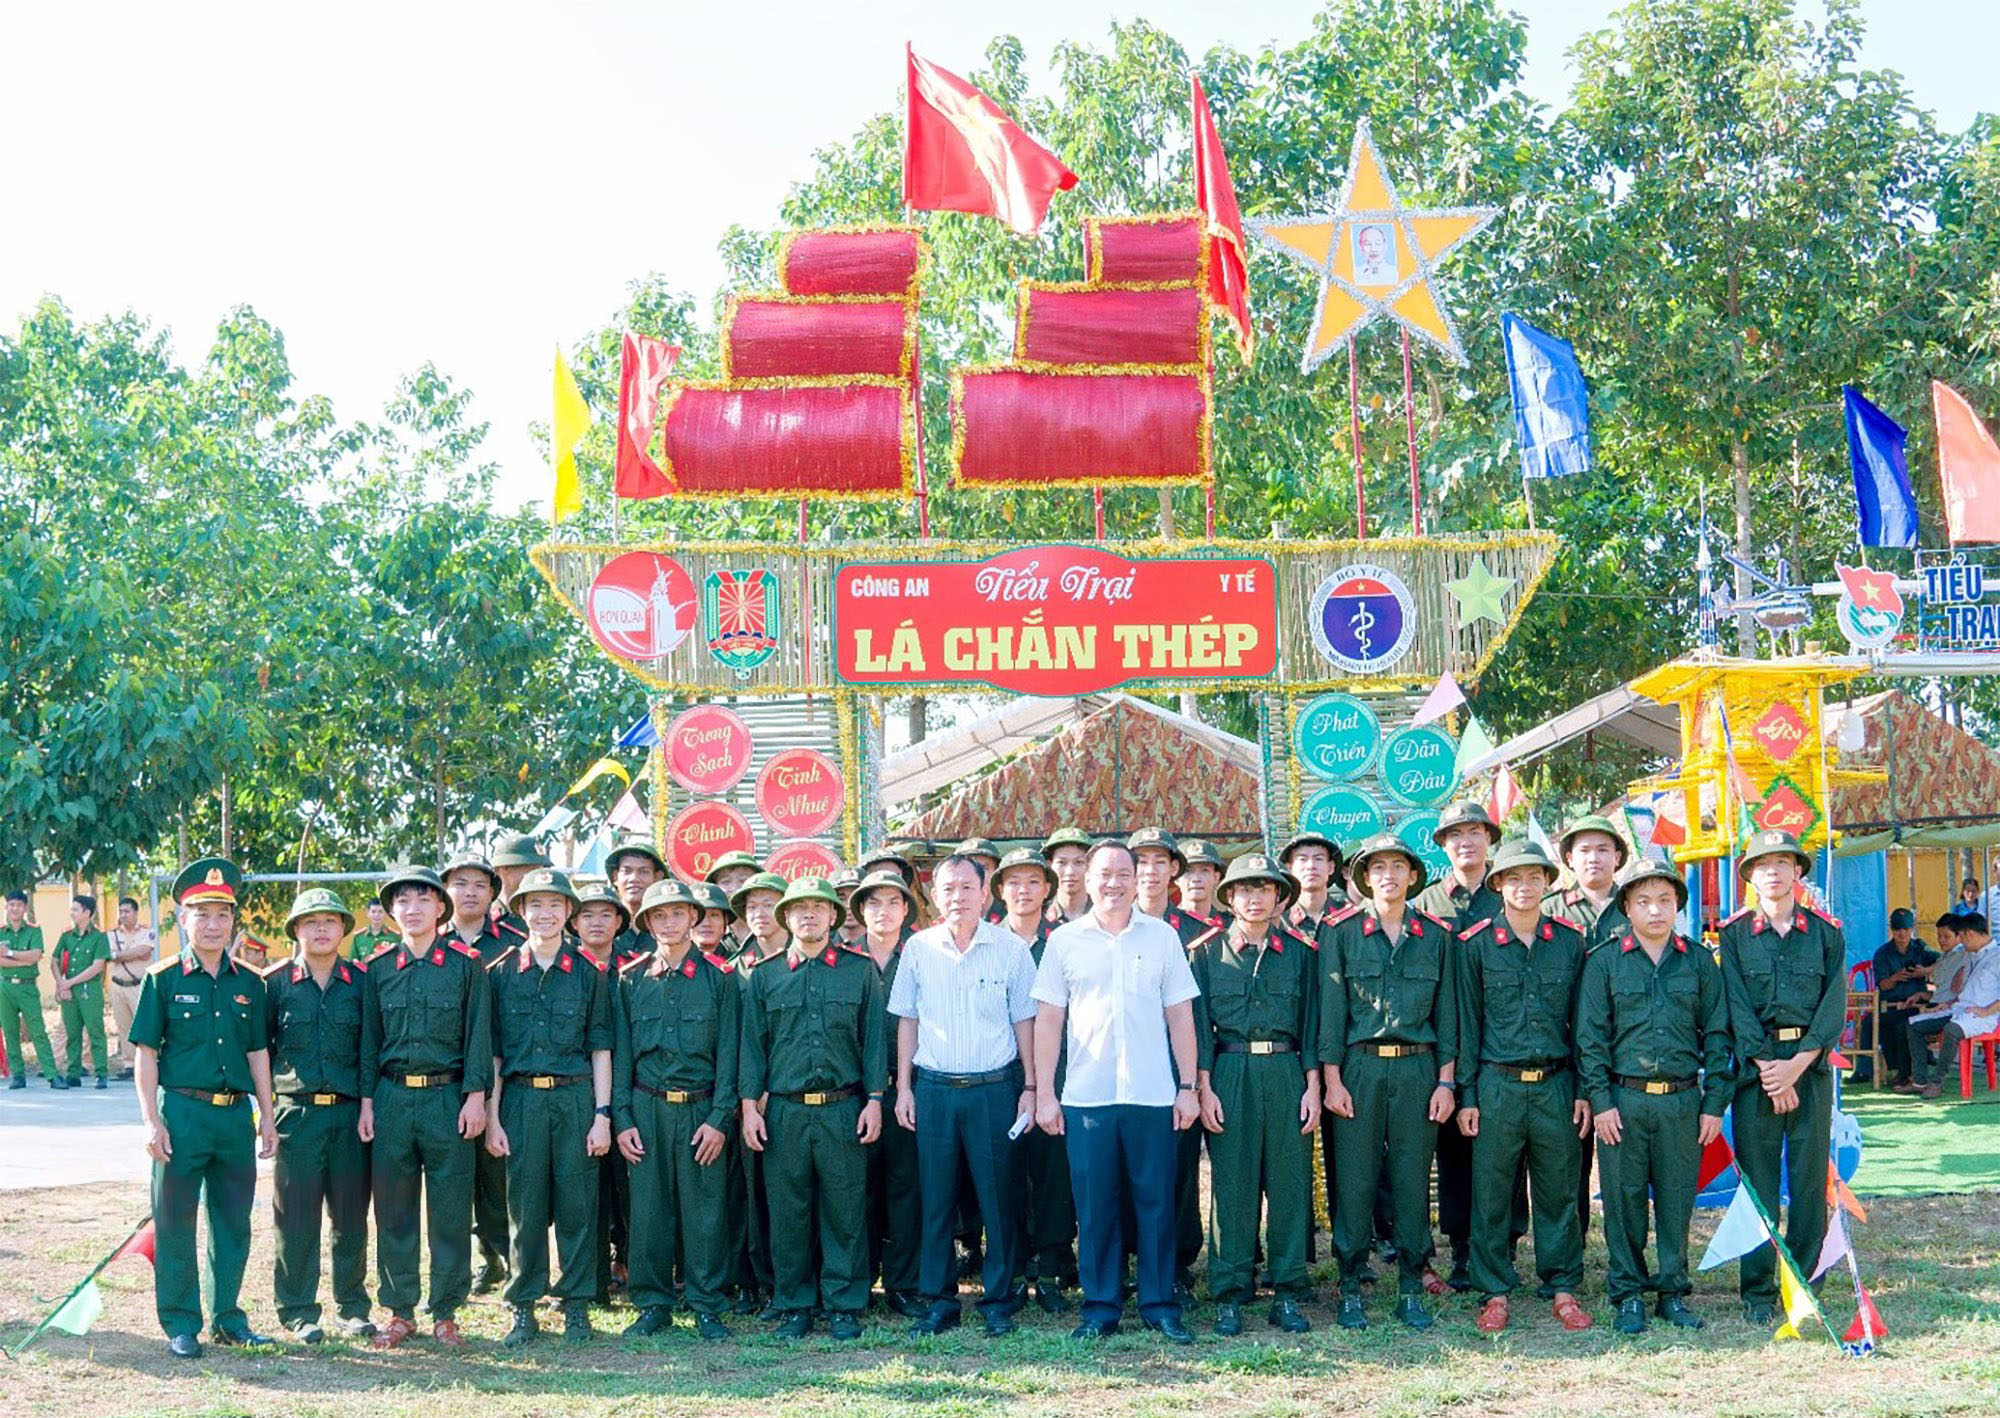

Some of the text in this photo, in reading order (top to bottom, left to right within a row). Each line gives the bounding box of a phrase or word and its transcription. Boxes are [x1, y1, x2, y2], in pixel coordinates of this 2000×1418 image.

[850, 574, 930, 597] CÔNG AN
[975, 560, 1136, 605] Tiểu Trại
[1218, 567, 1256, 592] Y TẾ
[1923, 552, 1984, 604] TIỂU
[854, 607, 1259, 672] LÁ CHẮN THÉP
[1313, 711, 1359, 736] Phát
[679, 727, 732, 748] Trong
[690, 747, 733, 777] Sạch
[1314, 741, 1366, 767] Triển
[1395, 740, 1441, 763] Dẫn
[772, 763, 821, 789] Tinh
[1400, 770, 1446, 795] Đầu
[774, 796, 829, 820] Nhuệ
[1312, 807, 1371, 832] Chuyên
[678, 819, 735, 846] Chính
[1418, 827, 1440, 853] Y
